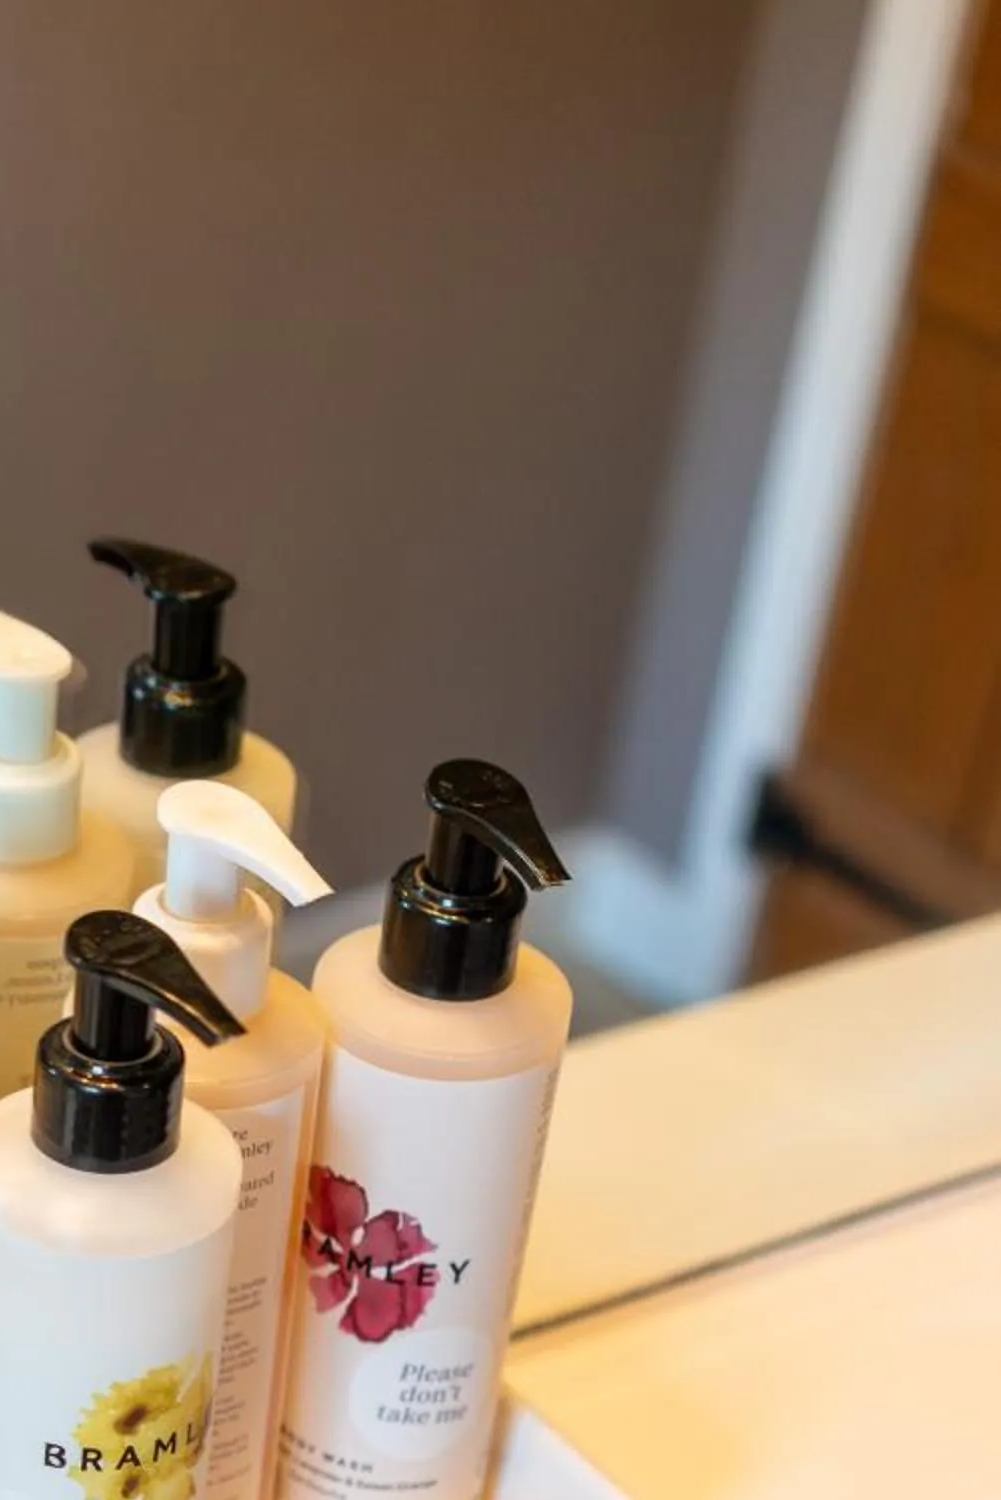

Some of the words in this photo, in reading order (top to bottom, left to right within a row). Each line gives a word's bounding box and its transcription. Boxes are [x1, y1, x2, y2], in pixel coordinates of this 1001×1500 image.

[400, 1361, 475, 1382] Please
[377, 1404, 430, 1425] take
[435, 1404, 468, 1425] me
